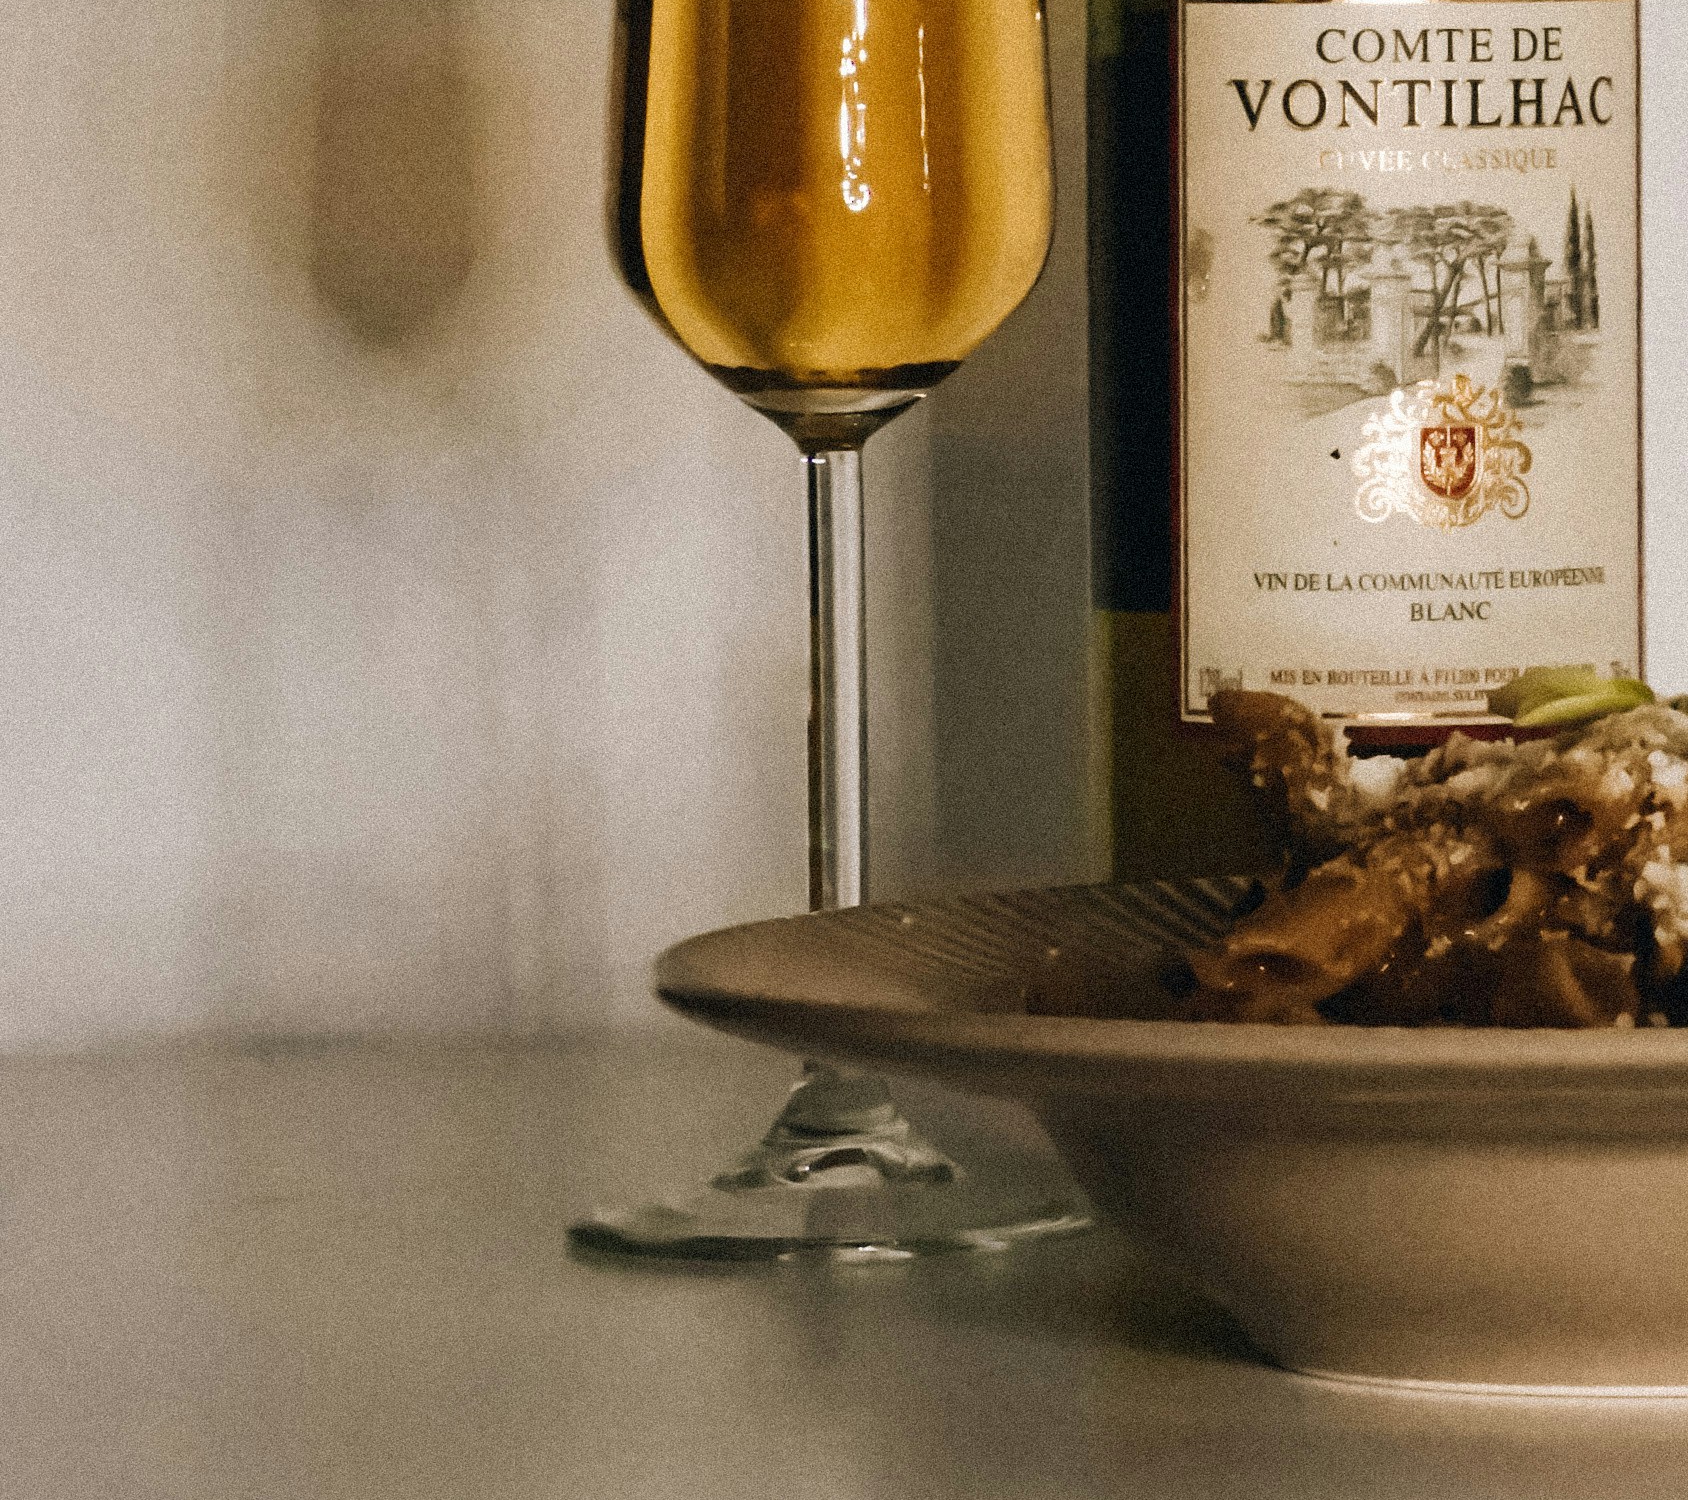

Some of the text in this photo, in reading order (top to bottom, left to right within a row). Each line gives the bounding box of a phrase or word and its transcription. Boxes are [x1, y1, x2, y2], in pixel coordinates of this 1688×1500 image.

[1316, 26, 1563, 63] COMTE DE
[1227, 75, 1614, 131] VONTILHAC
[1254, 572, 1288, 591] VIN
[1294, 573, 1321, 591] DE
[1327, 573, 1353, 591] LA
[1410, 602, 1491, 622] BLANC
